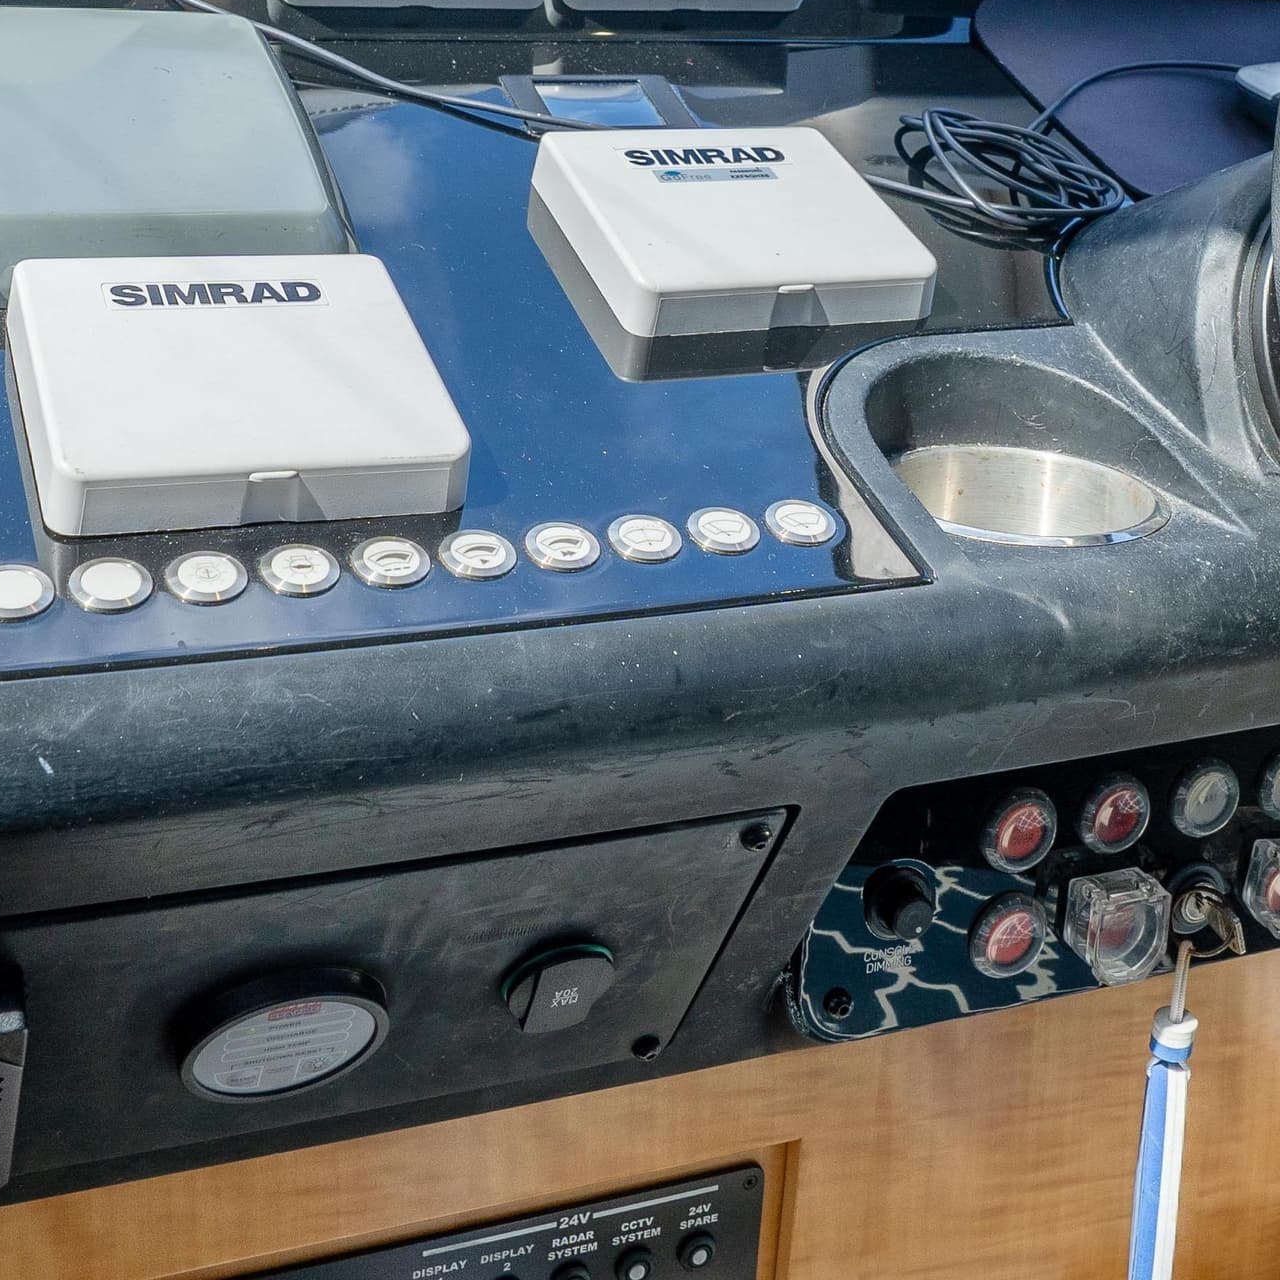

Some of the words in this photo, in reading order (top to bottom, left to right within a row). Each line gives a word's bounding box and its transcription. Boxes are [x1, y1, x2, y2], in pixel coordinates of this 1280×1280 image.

[624, 147, 785, 166] SIMRAD
[110, 282, 322, 306] SIMRAD
[689, 1203, 711, 1216] 24V
[559, 1212, 591, 1229] 24V
[621, 1217, 654, 1231] CCTV
[679, 1214, 718, 1230] SPARE
[552, 1230, 595, 1248] RADAR
[612, 1227, 661, 1246] SYSTEM
[480, 1244, 535, 1264] DISPLAY
[548, 1242, 598, 1261] SYSTEM
[412, 1260, 468, 1279] DISPLAY
[503, 1263, 511, 1271] 2
